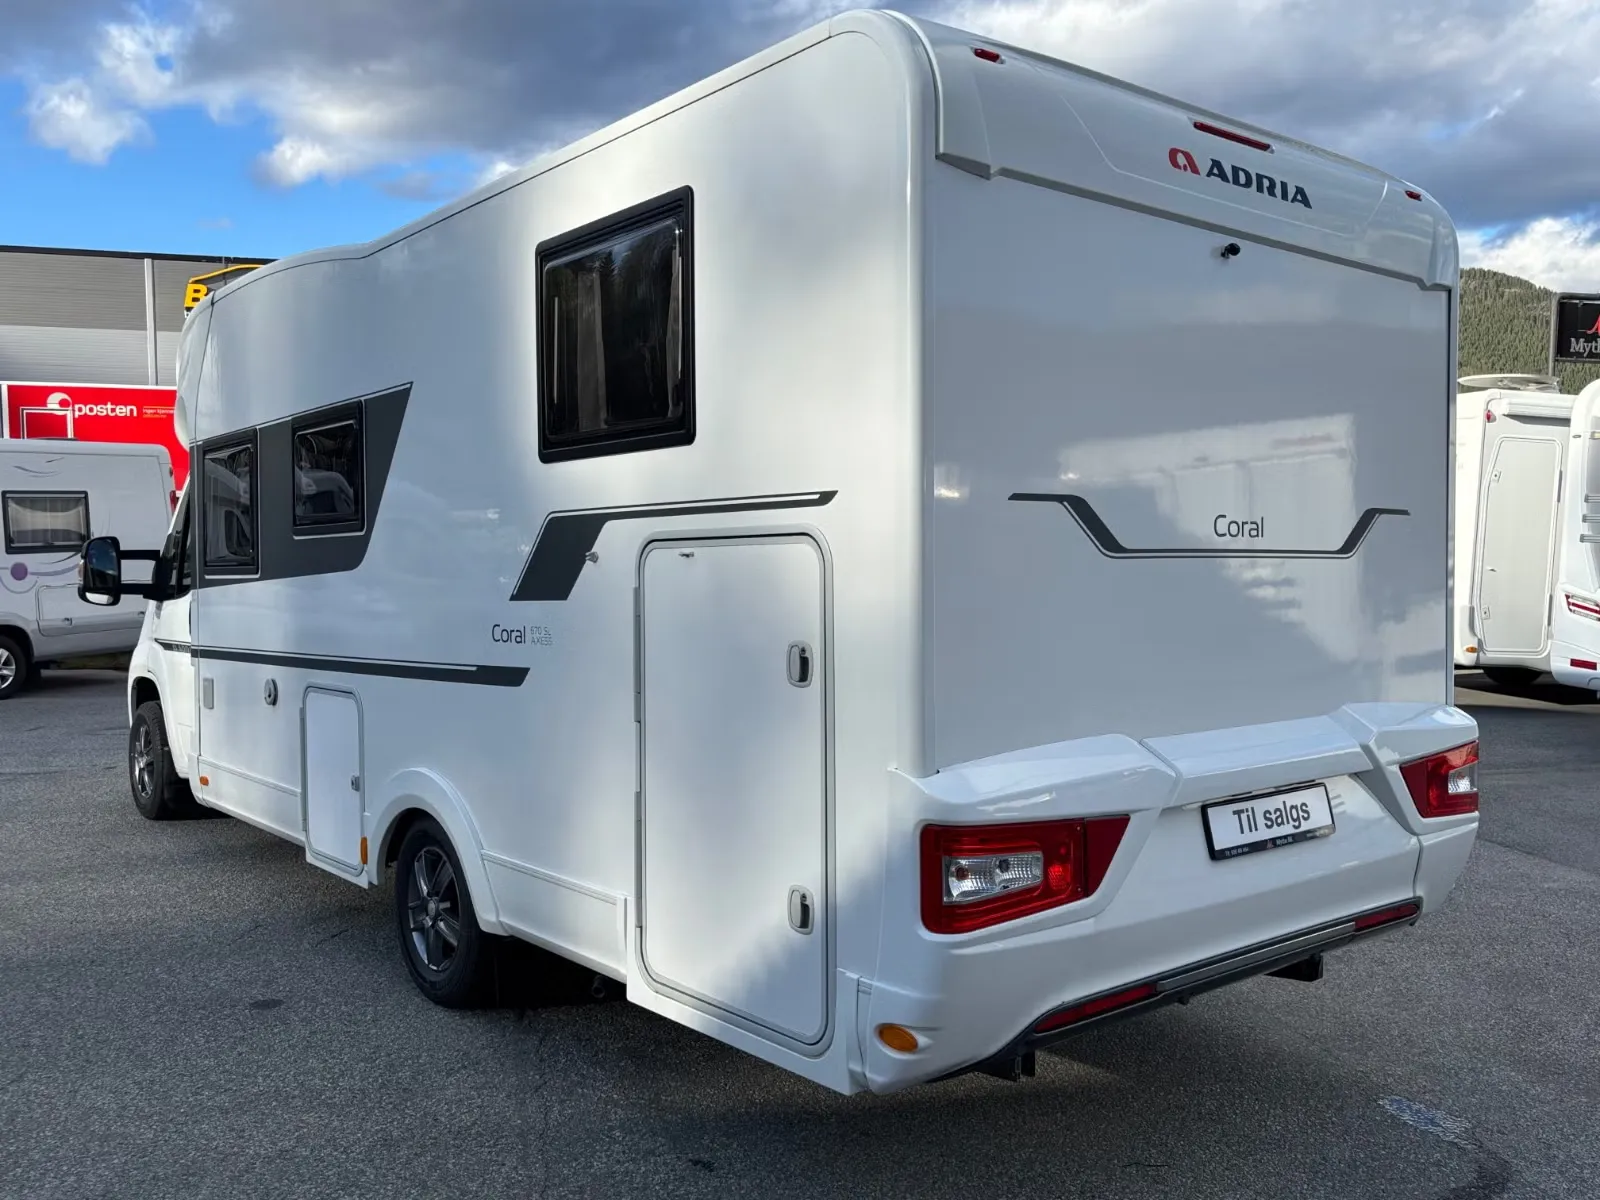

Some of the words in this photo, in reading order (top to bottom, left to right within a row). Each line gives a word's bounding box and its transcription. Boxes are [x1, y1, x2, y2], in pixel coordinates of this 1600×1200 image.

[1205, 158, 1313, 209] ADRIA
[74, 402, 137, 419] posten
[1213, 514, 1264, 538] Coral
[492, 624, 526, 644] Coral
[1232, 807, 1258, 834] Til
[1263, 800, 1310, 830] salgs
